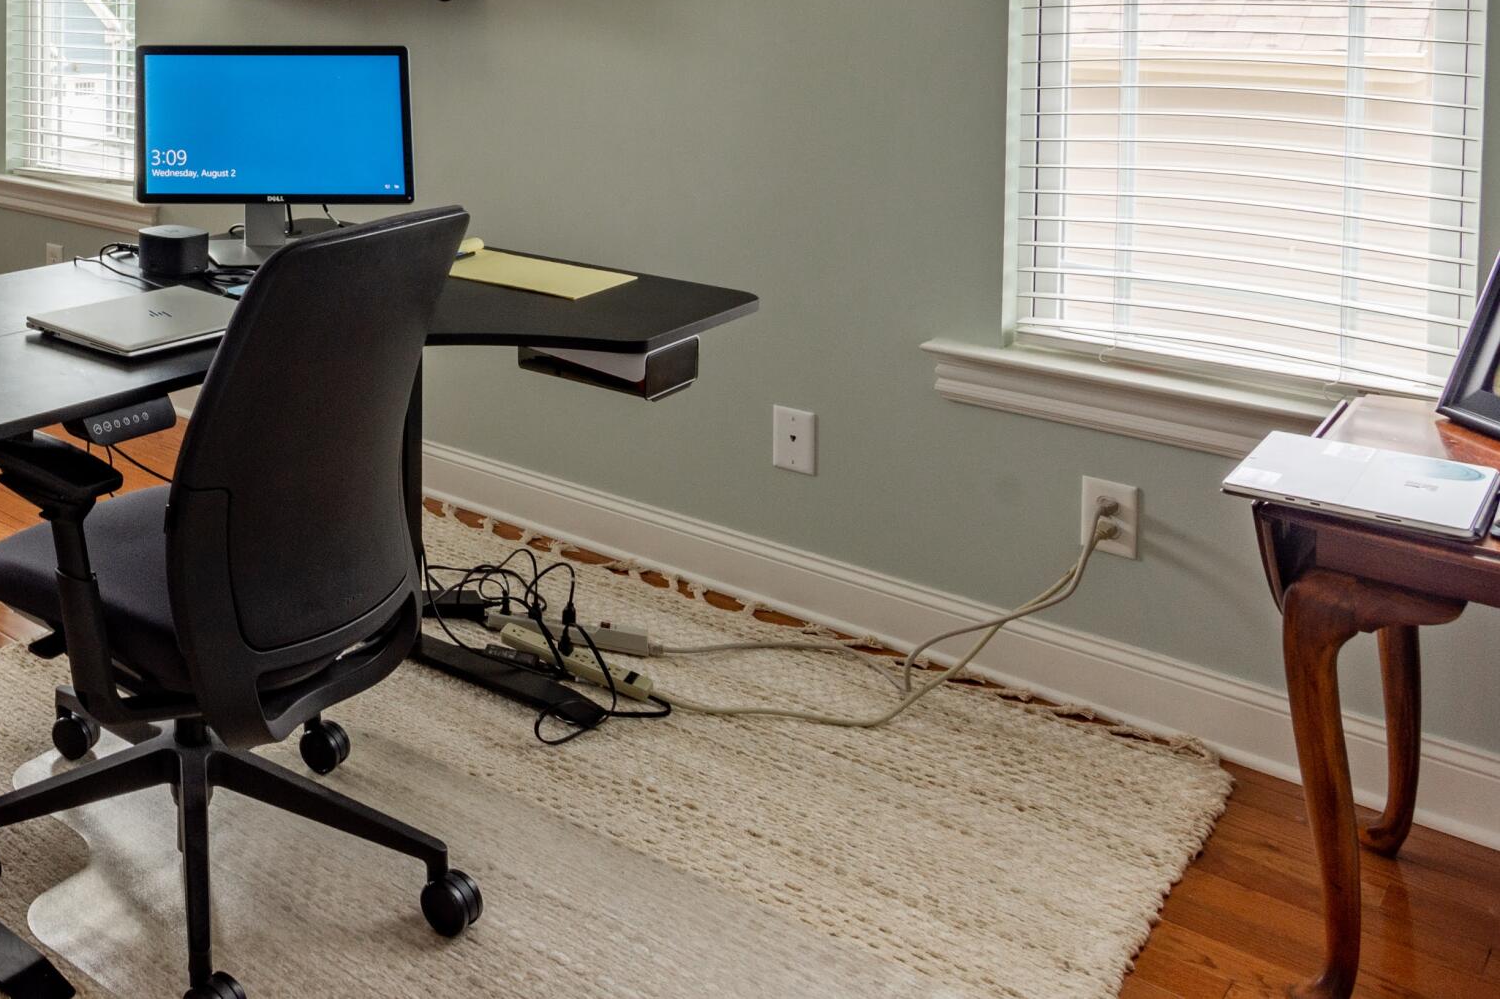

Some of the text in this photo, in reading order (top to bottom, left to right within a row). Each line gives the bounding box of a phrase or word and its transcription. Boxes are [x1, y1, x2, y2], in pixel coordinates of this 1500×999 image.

[151, 149, 187, 166] 3:09
[152, 169, 236, 179] Wednesday, August 2
